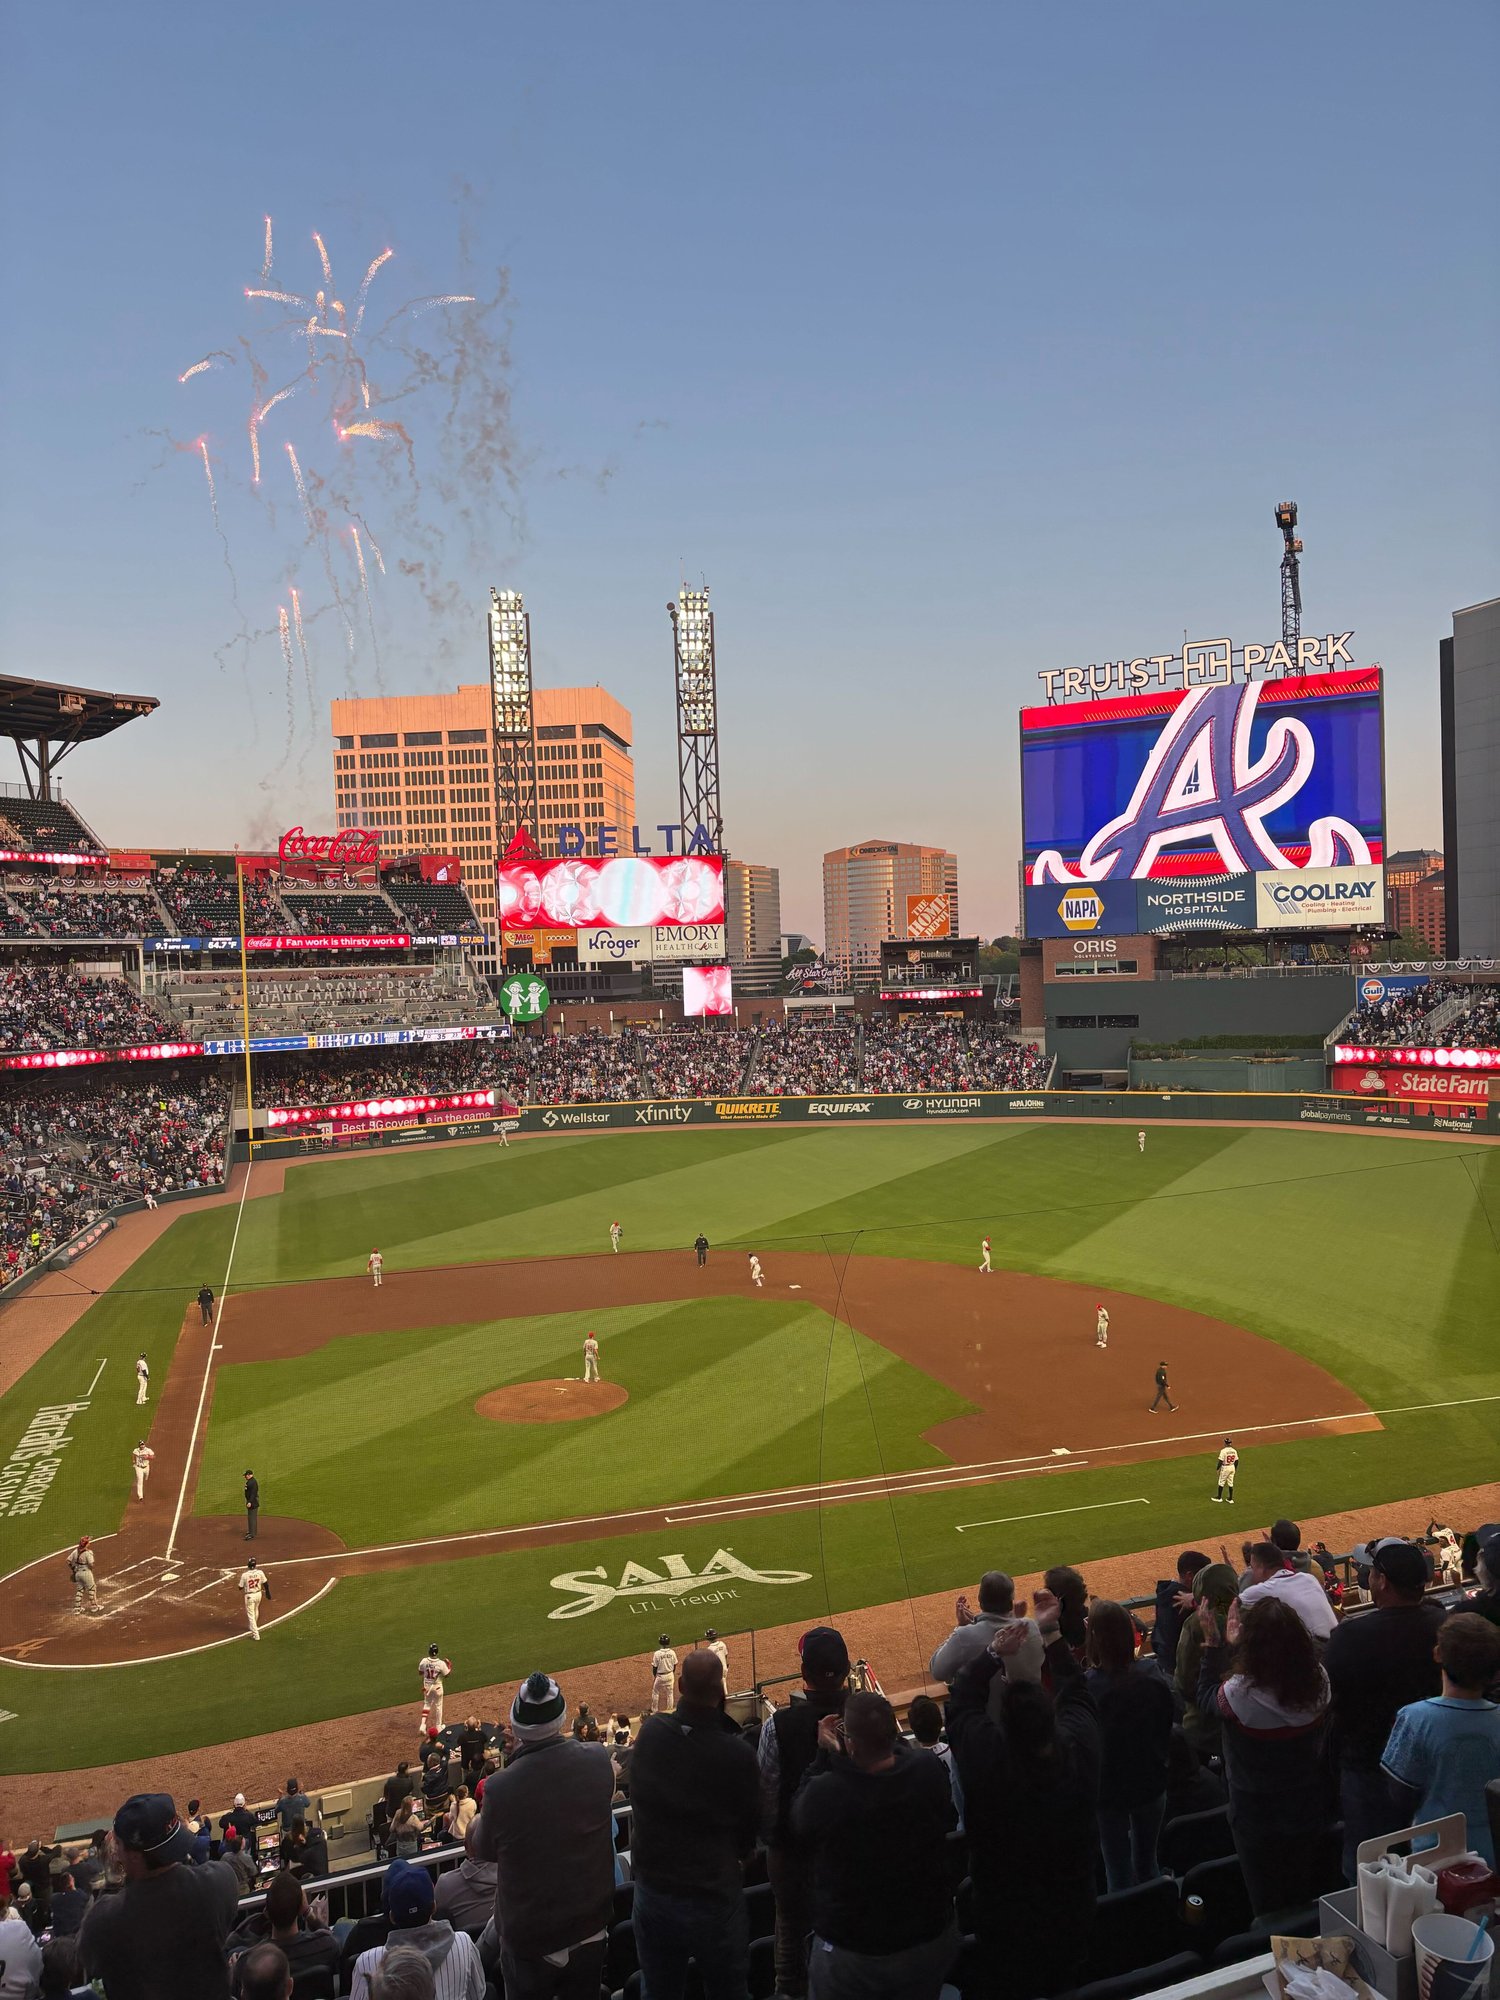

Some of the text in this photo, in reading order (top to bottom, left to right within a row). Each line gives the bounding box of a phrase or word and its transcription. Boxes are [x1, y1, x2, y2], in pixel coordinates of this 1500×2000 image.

[1038, 632, 1356, 698] TRUIST PARK
[559, 823, 714, 855] DELTA
[1147, 890, 1246, 906] NORTHSIDE
[1273, 881, 1376, 902] COOLRAY
[908, 894, 949, 936] HOME
[911, 899, 929, 916] THE
[1065, 900, 1098, 918] NAPA
[1165, 905, 1228, 915] HOSPITAL
[924, 909, 949, 936] DEPOT
[286, 937, 395, 947] Fan work is thirsty work
[412, 937, 426, 945] 7:53
[427, 937, 438, 945] PM
[656, 925, 721, 942] EMORY
[588, 929, 641, 959] Kroger
[656, 942, 719, 951] HEALTHCARE
[1073, 940, 1117, 953] ORIS
[1364, 986, 1384, 994] Gulf
[1401, 1073, 1448, 1093] State
[715, 1102, 780, 1115] QUIKRETE
[808, 1102, 871, 1115] EQUIFAX
[926, 1098, 981, 1108] HYUNDAI
[341, 1122, 366, 1133] Best
[369, 1120, 384, 1131] 5G
[385, 1116, 432, 1128] coverae
[434, 1115, 443, 1123] in
[446, 1113, 461, 1122] the
[463, 1111, 491, 1121] game
[561, 1112, 610, 1124] Wellstar
[635, 1104, 693, 1123] xfinity
[1442, 1121, 1474, 1129] National
[8, 1458, 63, 1517] CHEROKEE
[248, 1578, 260, 1589] 27
[547, 1548, 813, 1620] SAIA
[629, 1588, 742, 1615] LTL Freight
